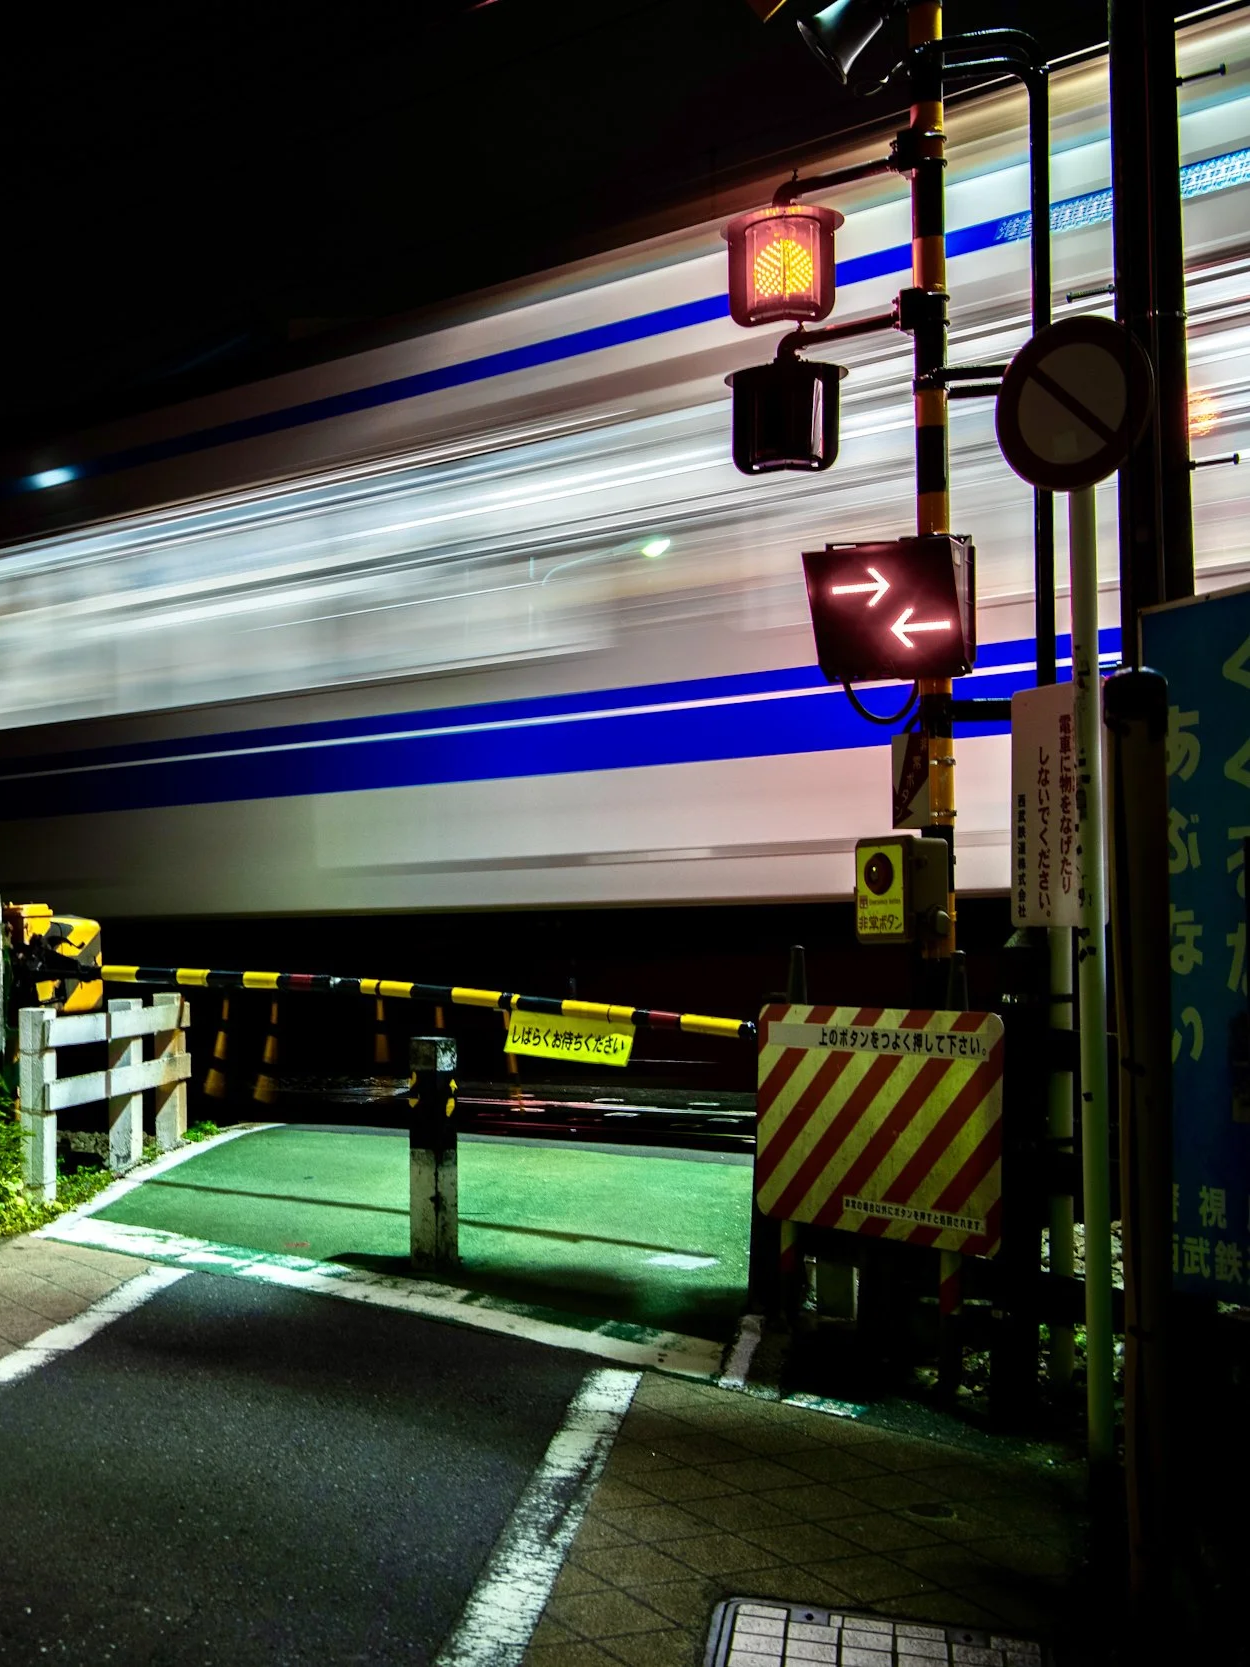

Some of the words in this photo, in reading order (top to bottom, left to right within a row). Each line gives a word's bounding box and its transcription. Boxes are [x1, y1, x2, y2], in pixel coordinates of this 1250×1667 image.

[1037, 746, 1051, 918] しないでください。
[1058, 714, 1073, 894] 電車に物をなげたり
[512, 1025, 625, 1054] しばらくお待ちください
[819, 1028, 987, 1057] 上のボタンをつよく押して下さい。
